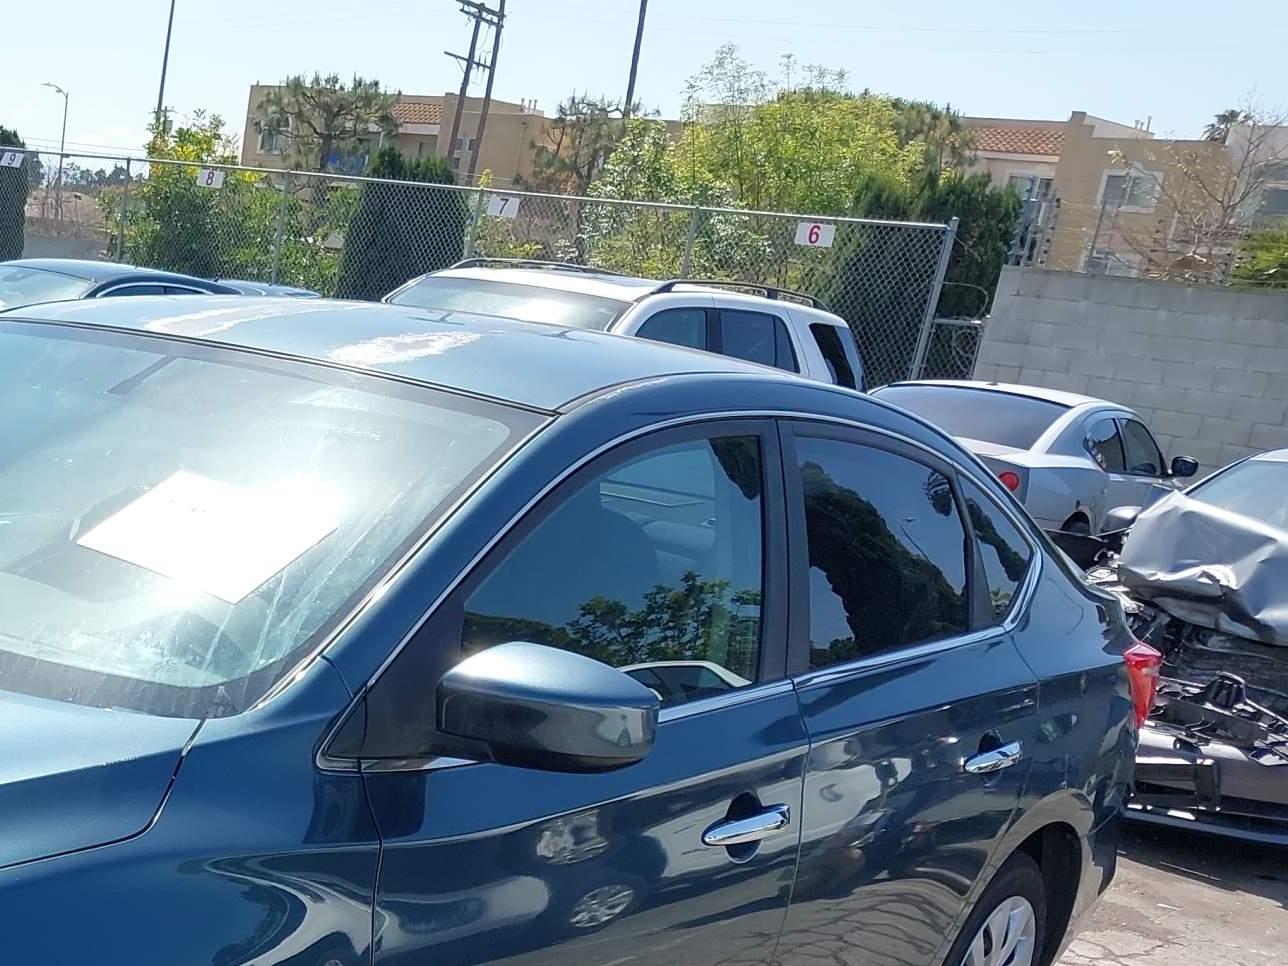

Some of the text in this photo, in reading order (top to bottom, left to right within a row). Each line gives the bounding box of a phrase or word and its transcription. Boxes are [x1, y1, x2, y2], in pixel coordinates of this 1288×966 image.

[7, 153, 17, 166] 9
[205, 171, 215, 186] 8
[499, 198, 510, 215] 7
[808, 225, 821, 244] 6
